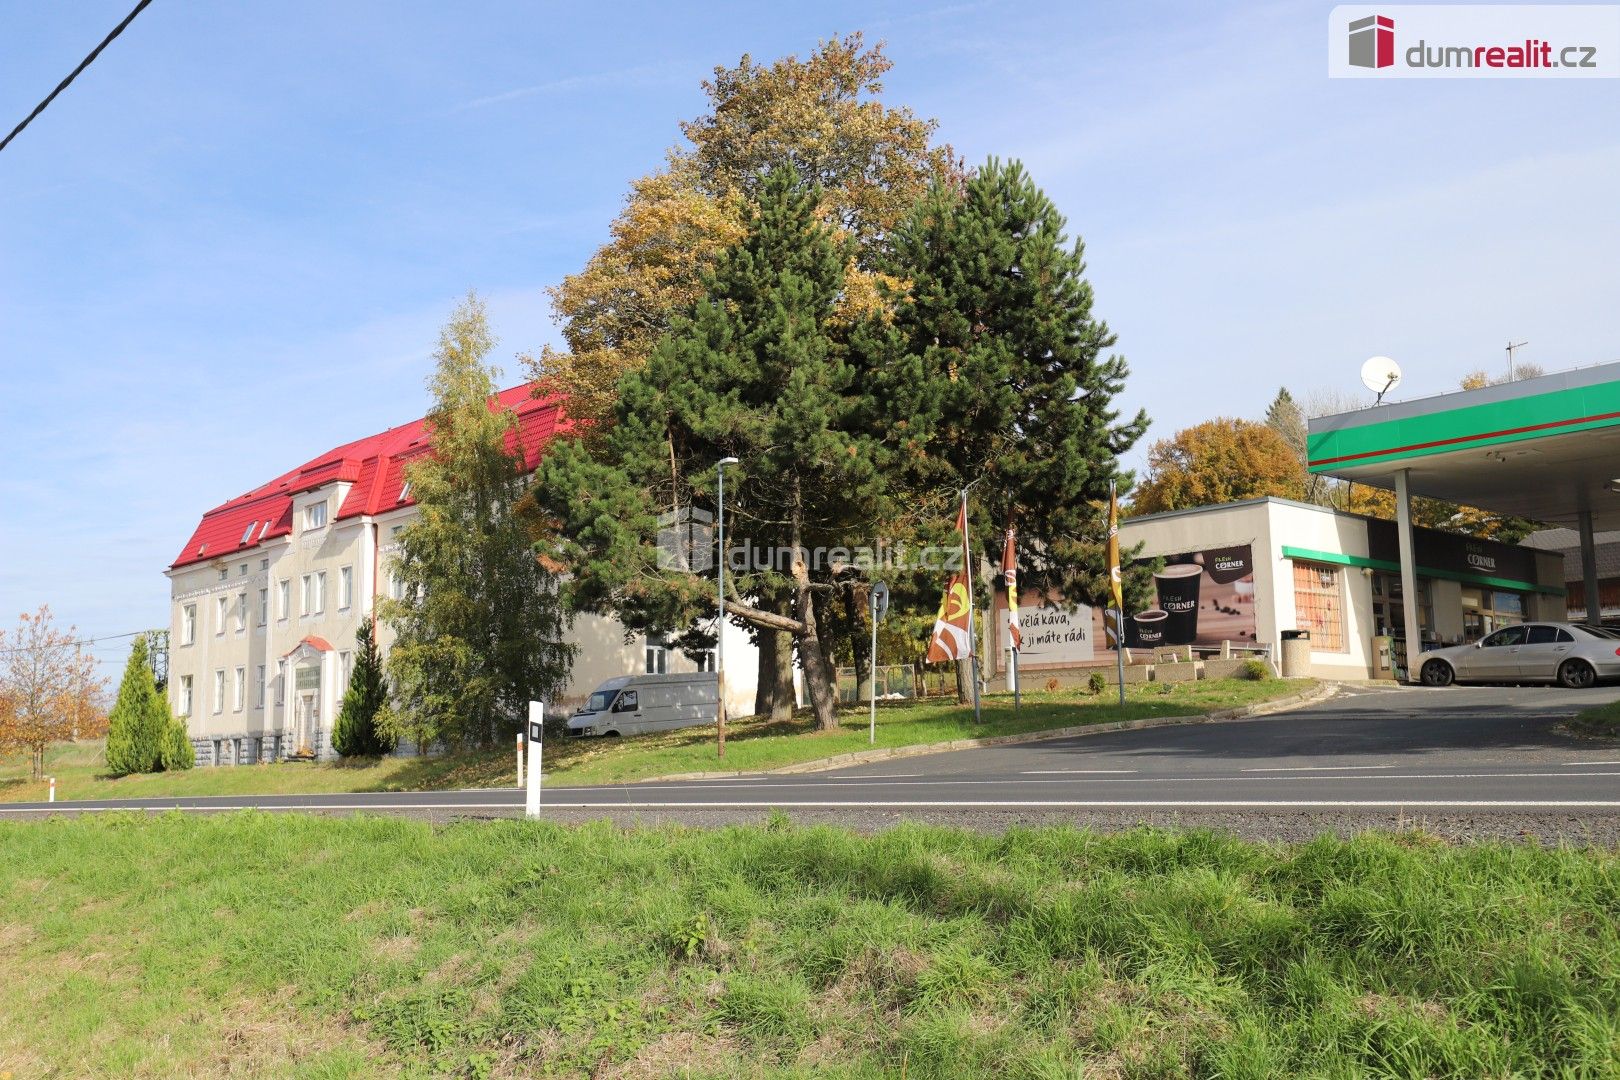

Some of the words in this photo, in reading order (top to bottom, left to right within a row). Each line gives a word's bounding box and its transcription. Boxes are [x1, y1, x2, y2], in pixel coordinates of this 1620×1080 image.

[1215, 560, 1244, 570] CORNER
[1467, 554, 1496, 568] CORNER
[1163, 600, 1195, 611] CORNER
[1041, 611, 1070, 627] káva,
[1036, 630, 1062, 644] máte
[1064, 627, 1086, 643] rádi
